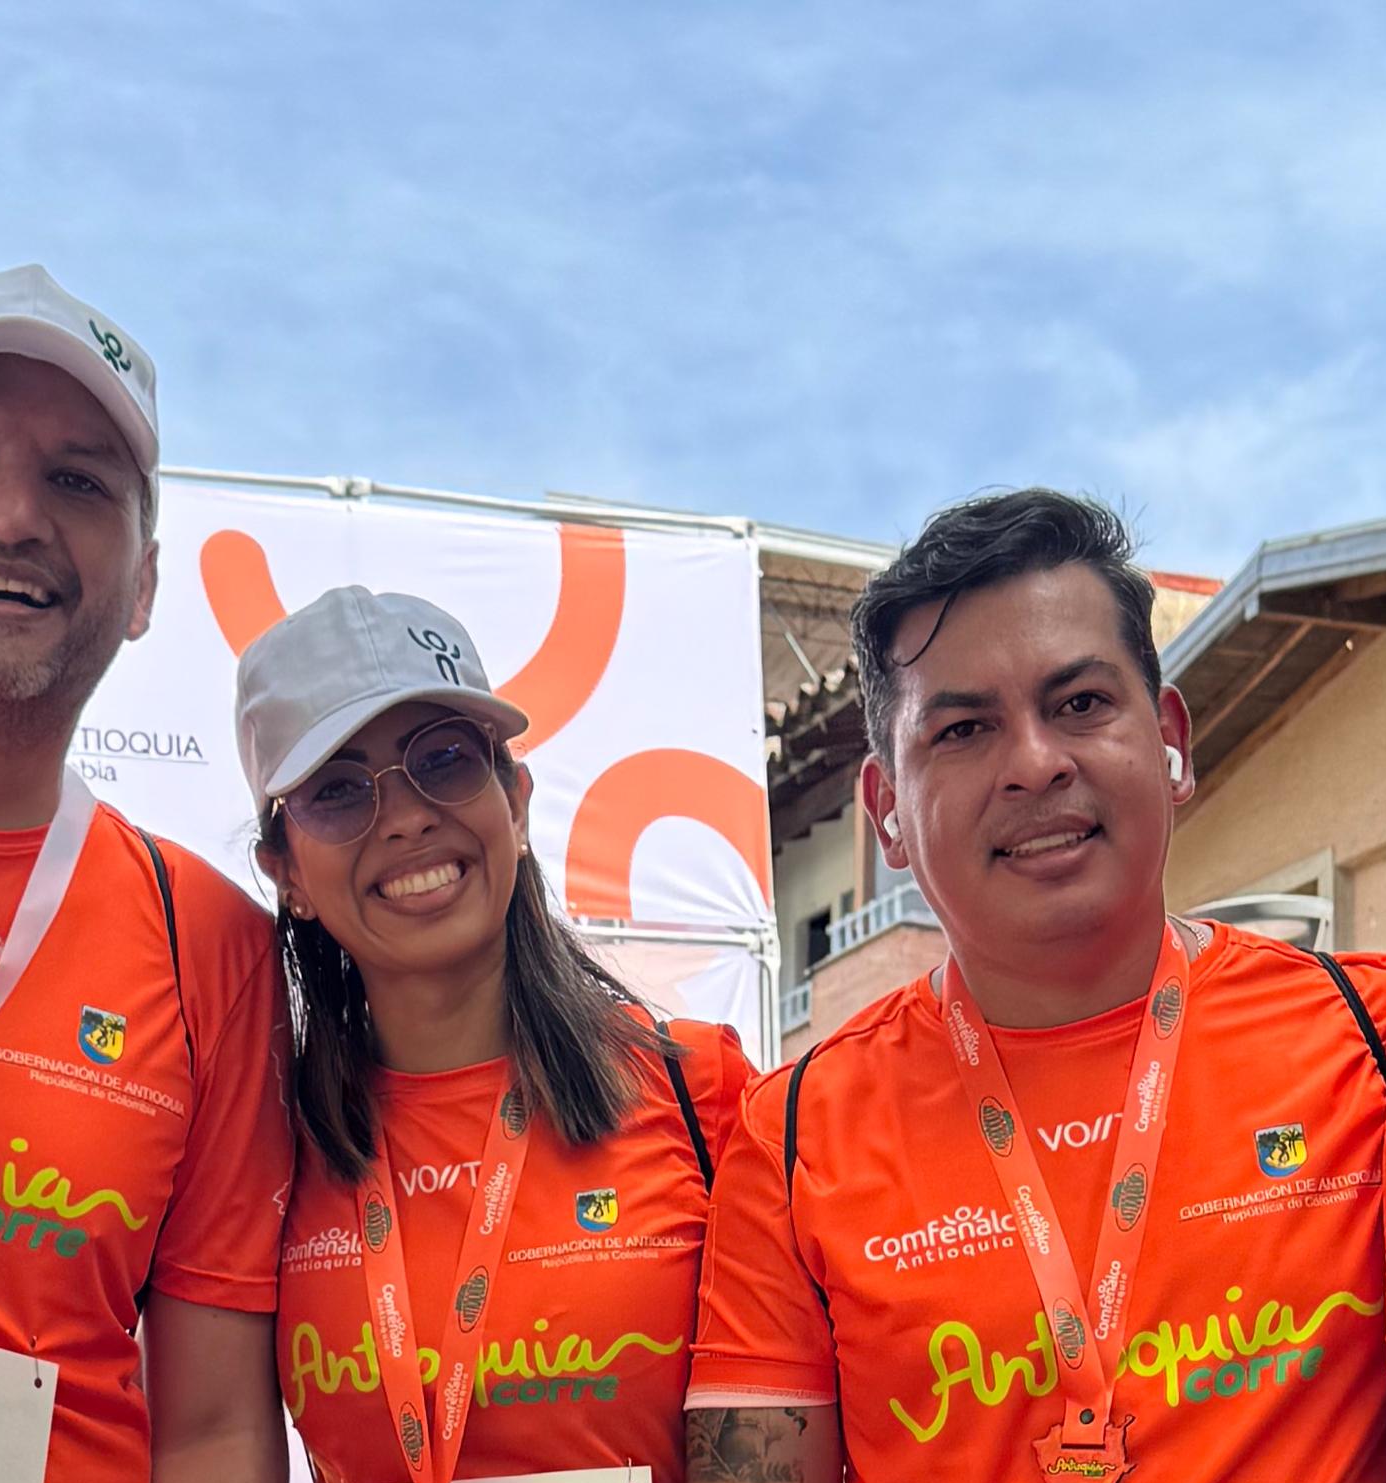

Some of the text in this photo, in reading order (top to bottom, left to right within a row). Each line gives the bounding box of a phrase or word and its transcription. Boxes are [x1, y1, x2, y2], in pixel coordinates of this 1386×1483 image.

[80, 727, 203, 758] TIOQUIA
[102, 1073, 121, 1089] DE
[1296, 1181, 1316, 1193] DE
[605, 1237, 623, 1249] DE
[865, 1208, 1017, 1263] Comfenalc
[894, 1236, 1014, 1273] Antioquia
[1094, 1260, 1121, 1340] Comfenalco
[889, 1286, 1383, 1443] Antoquia
[1182, 1344, 1325, 1403] corre
[491, 1374, 620, 1406] corre
